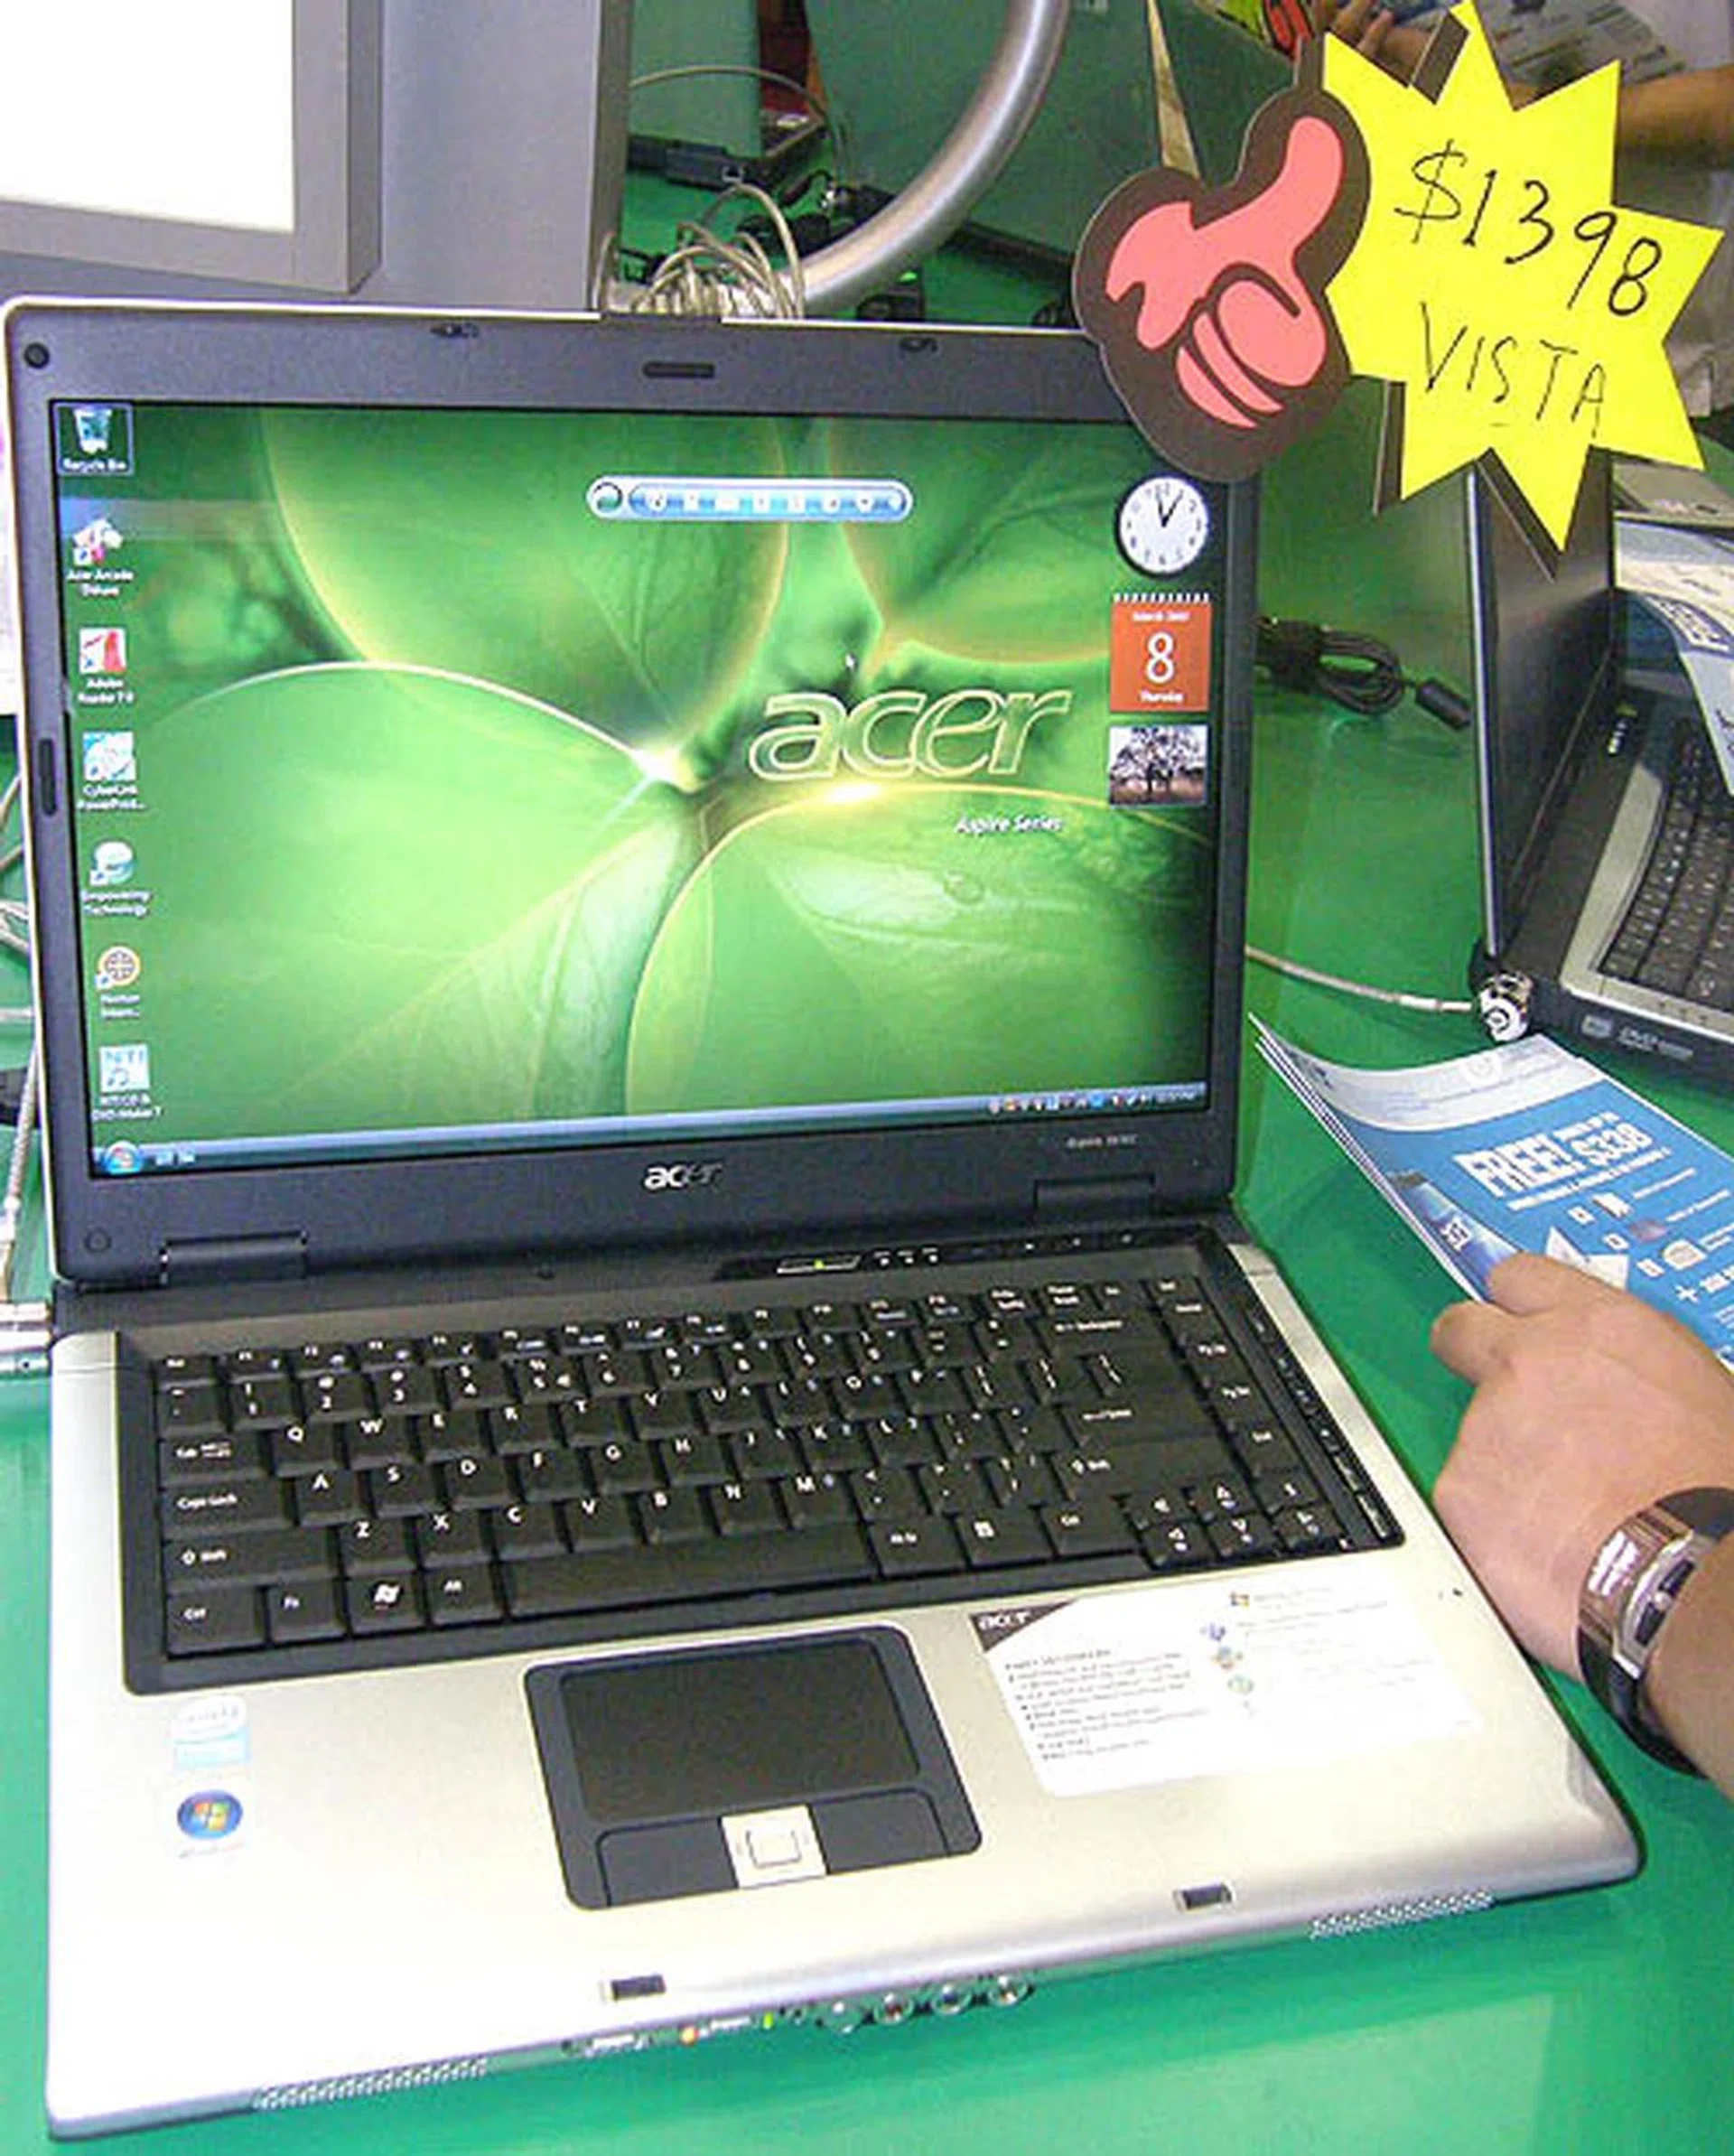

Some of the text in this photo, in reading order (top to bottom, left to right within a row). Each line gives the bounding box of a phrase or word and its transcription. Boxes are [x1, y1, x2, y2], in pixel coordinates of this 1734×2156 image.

[1393, 138, 1663, 316] $1398
[1418, 300, 1608, 438] VISTA
[1146, 631, 1174, 685] 8
[749, 689, 1073, 780] acer
[954, 814, 1063, 837] Aspire Series
[644, 1163, 724, 1191] acer
[1453, 1132, 1588, 1199] FREE!
